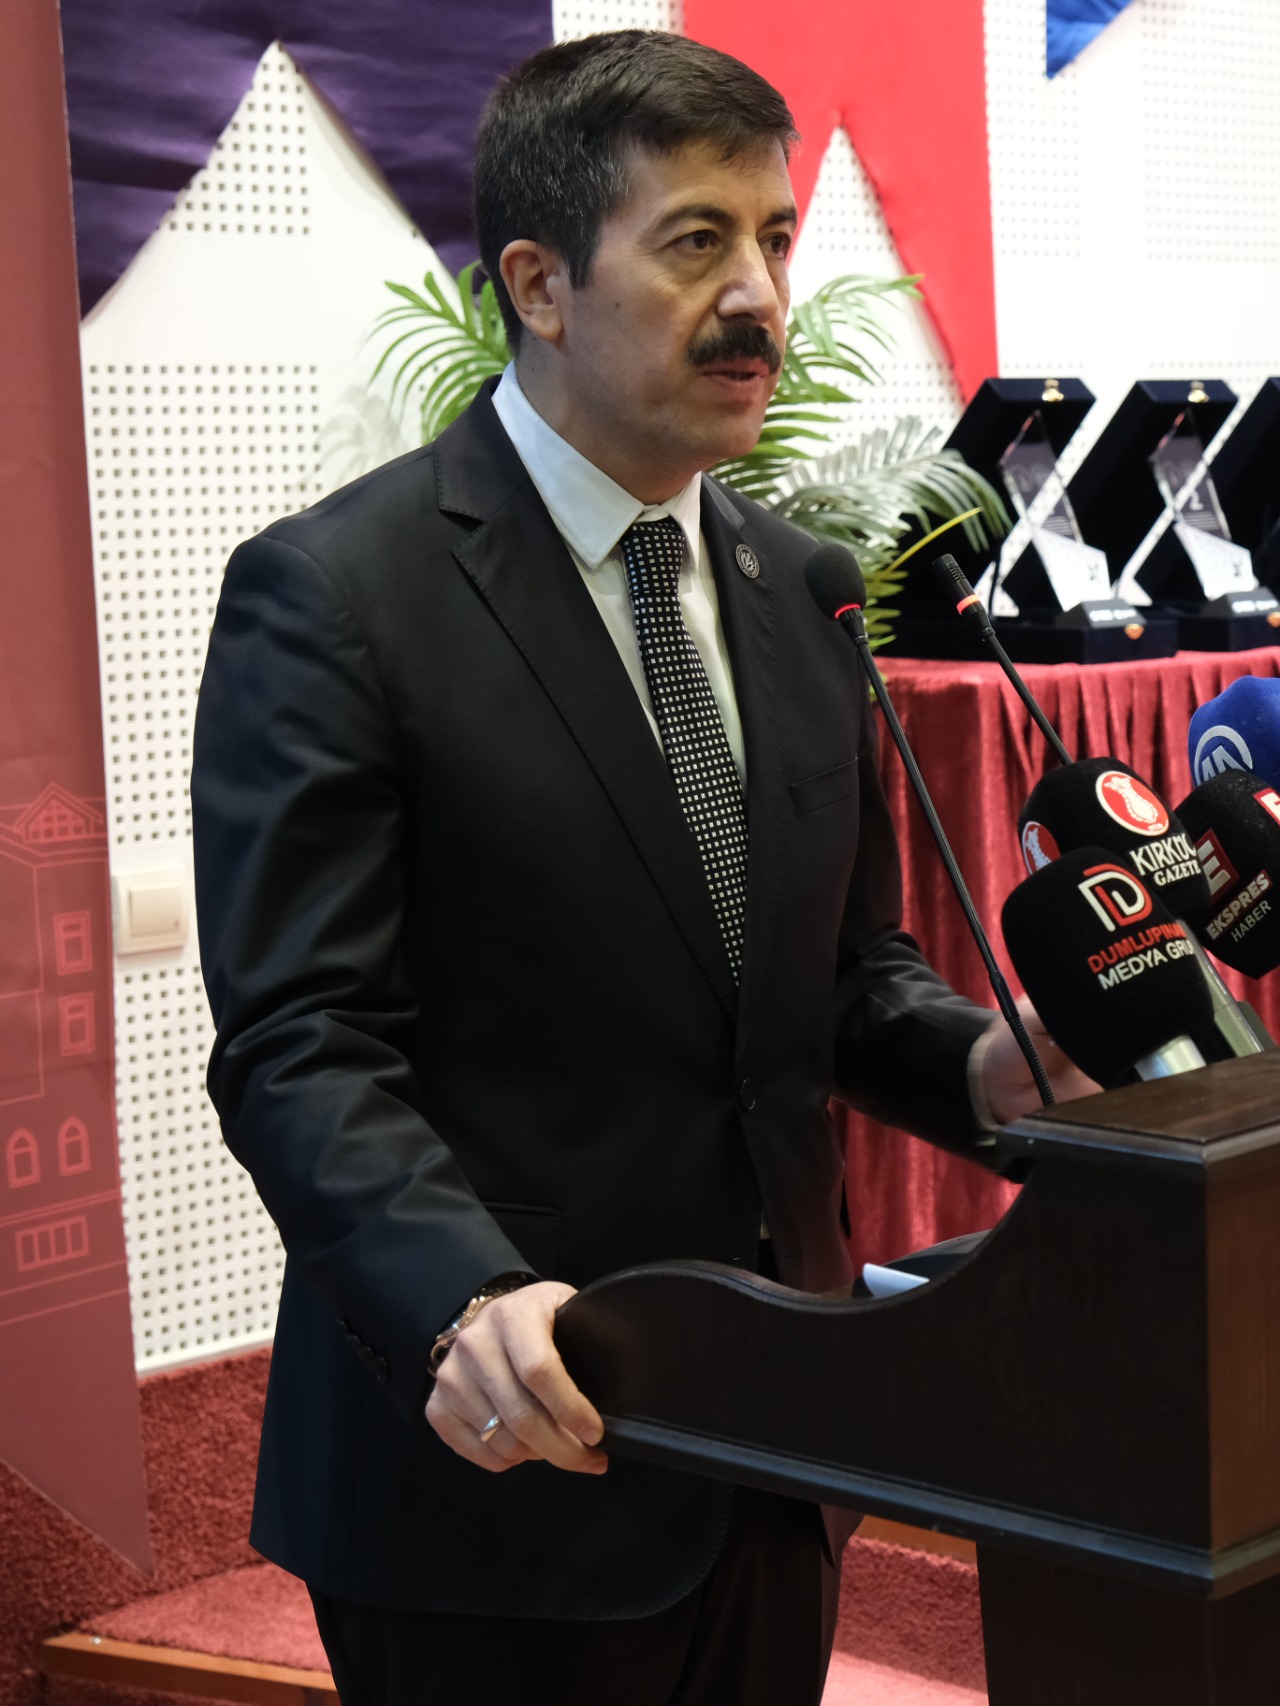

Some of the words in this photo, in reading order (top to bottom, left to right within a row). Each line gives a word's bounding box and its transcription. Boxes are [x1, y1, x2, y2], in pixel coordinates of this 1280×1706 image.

[1206, 873, 1271, 940] EKSPRES
[1231, 900, 1272, 942] HABER
[1097, 948, 1168, 990] MEDYA
